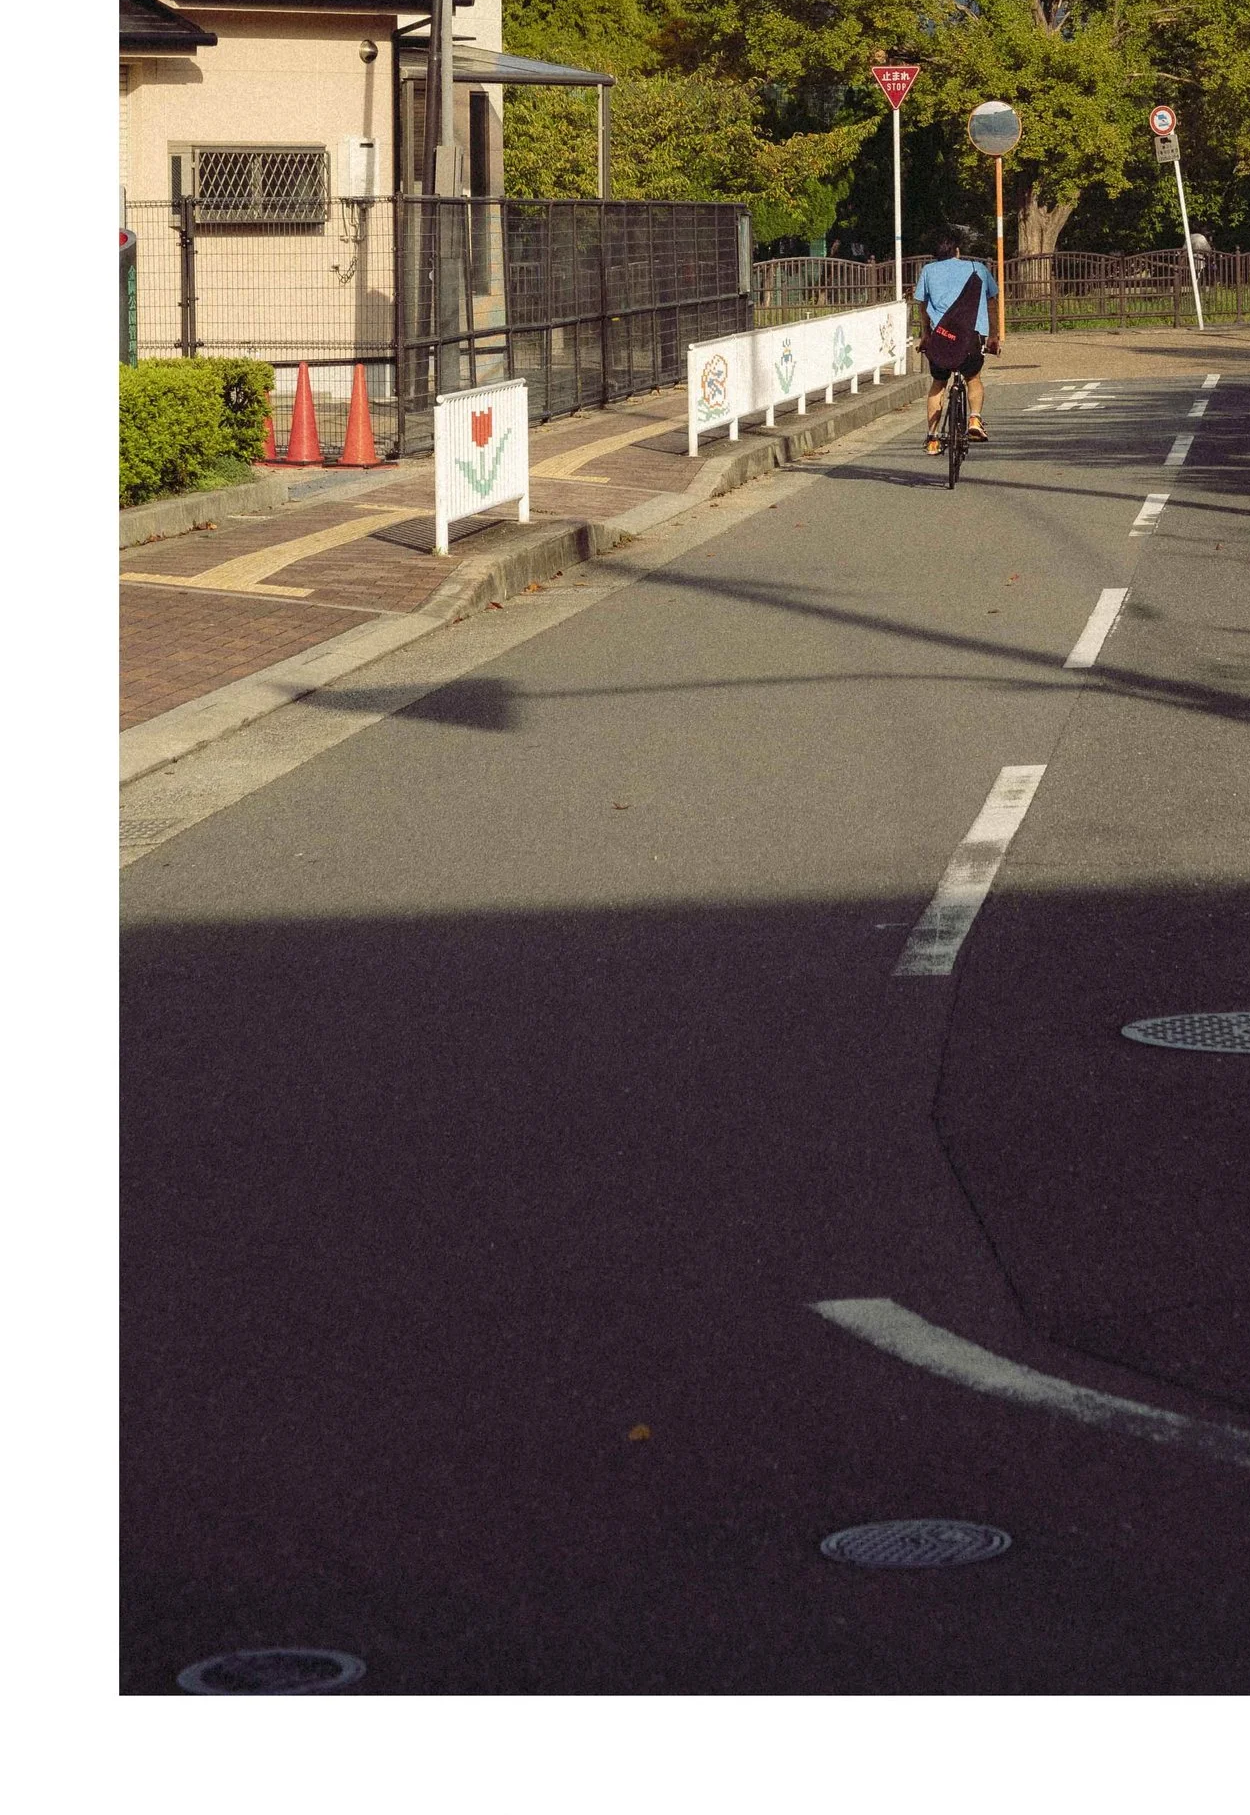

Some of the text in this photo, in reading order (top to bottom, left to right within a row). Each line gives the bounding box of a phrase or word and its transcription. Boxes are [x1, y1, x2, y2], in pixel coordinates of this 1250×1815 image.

[881, 71, 910, 82] 止まれ
[886, 83, 907, 91] STOP
